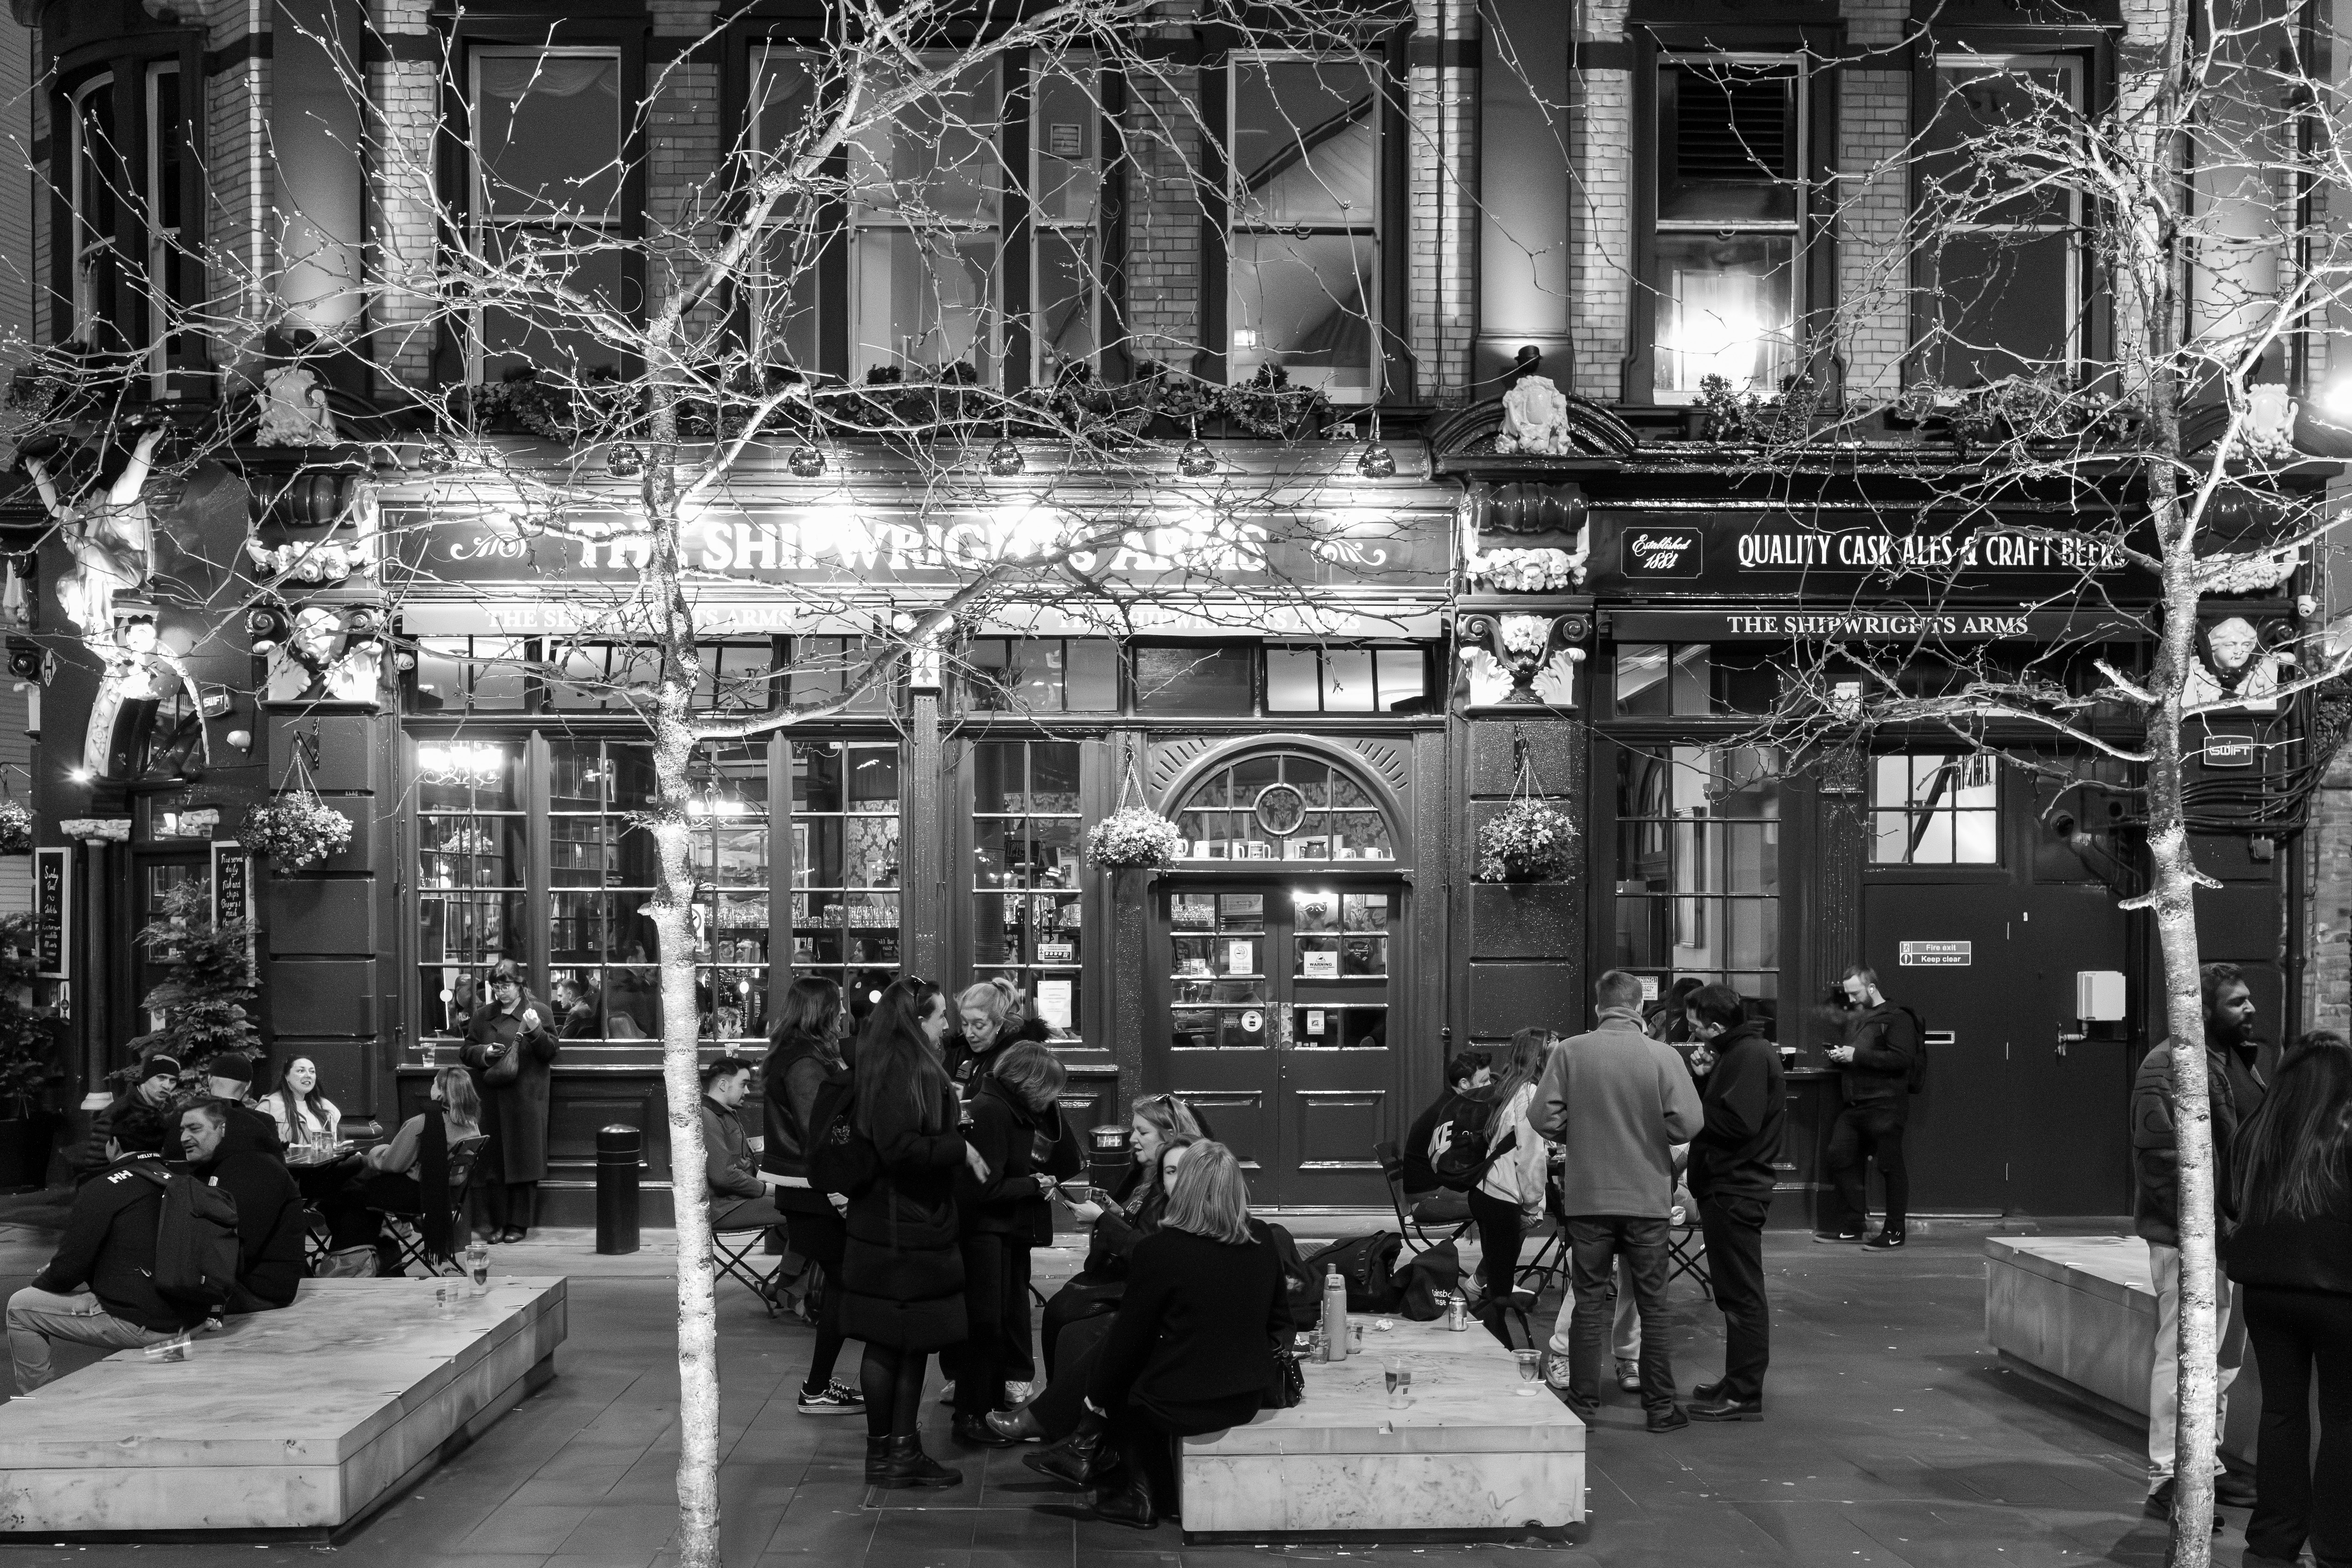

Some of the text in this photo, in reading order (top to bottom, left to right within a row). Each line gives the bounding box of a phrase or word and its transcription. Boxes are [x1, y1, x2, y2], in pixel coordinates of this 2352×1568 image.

[569, 522, 688, 568] TH
[1632, 534, 1692, 556] Established
[1738, 535, 1831, 567] QUALITY
[1839, 535, 1892, 565] CASK
[1903, 535, 1952, 565] ALES
[1986, 536, 2053, 566] CRAFT
[485, 610, 538, 627] THE
[722, 608, 792, 627] ARMS
[1727, 616, 1778, 633] THE
[1962, 616, 2028, 634] ARMS
[203, 695, 224, 708] SWIFT
[2209, 745, 2250, 756] SWIFT
[1921, 955, 1941, 964] Keep
